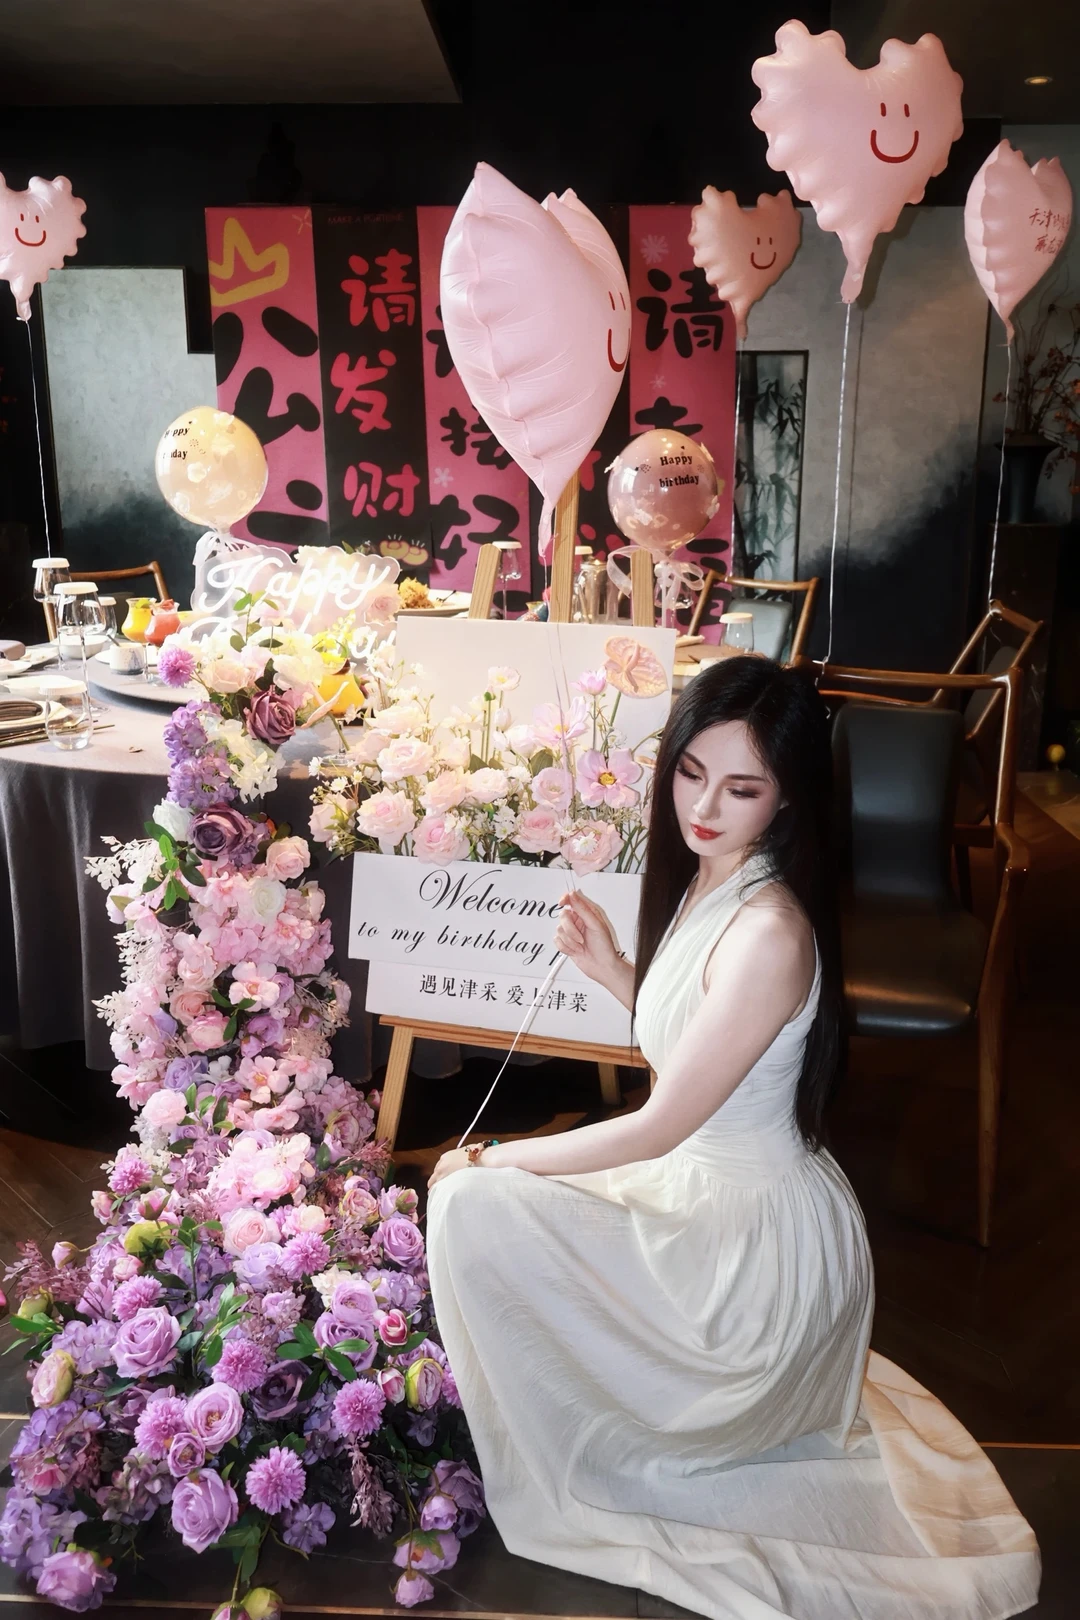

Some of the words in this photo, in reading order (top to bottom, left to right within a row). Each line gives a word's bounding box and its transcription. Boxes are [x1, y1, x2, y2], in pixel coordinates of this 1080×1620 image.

[330, 248, 421, 518] 请发财
[659, 474, 698, 487] birthday
[660, 456, 692, 466] Happy
[199, 554, 391, 616] Happy
[418, 869, 564, 918] Welcome
[357, 921, 380, 937] to
[391, 929, 426, 953] my
[437, 925, 545, 966] birthday
[419, 974, 498, 1001] 遇见津采
[505, 984, 588, 1013] 爱上津菜
